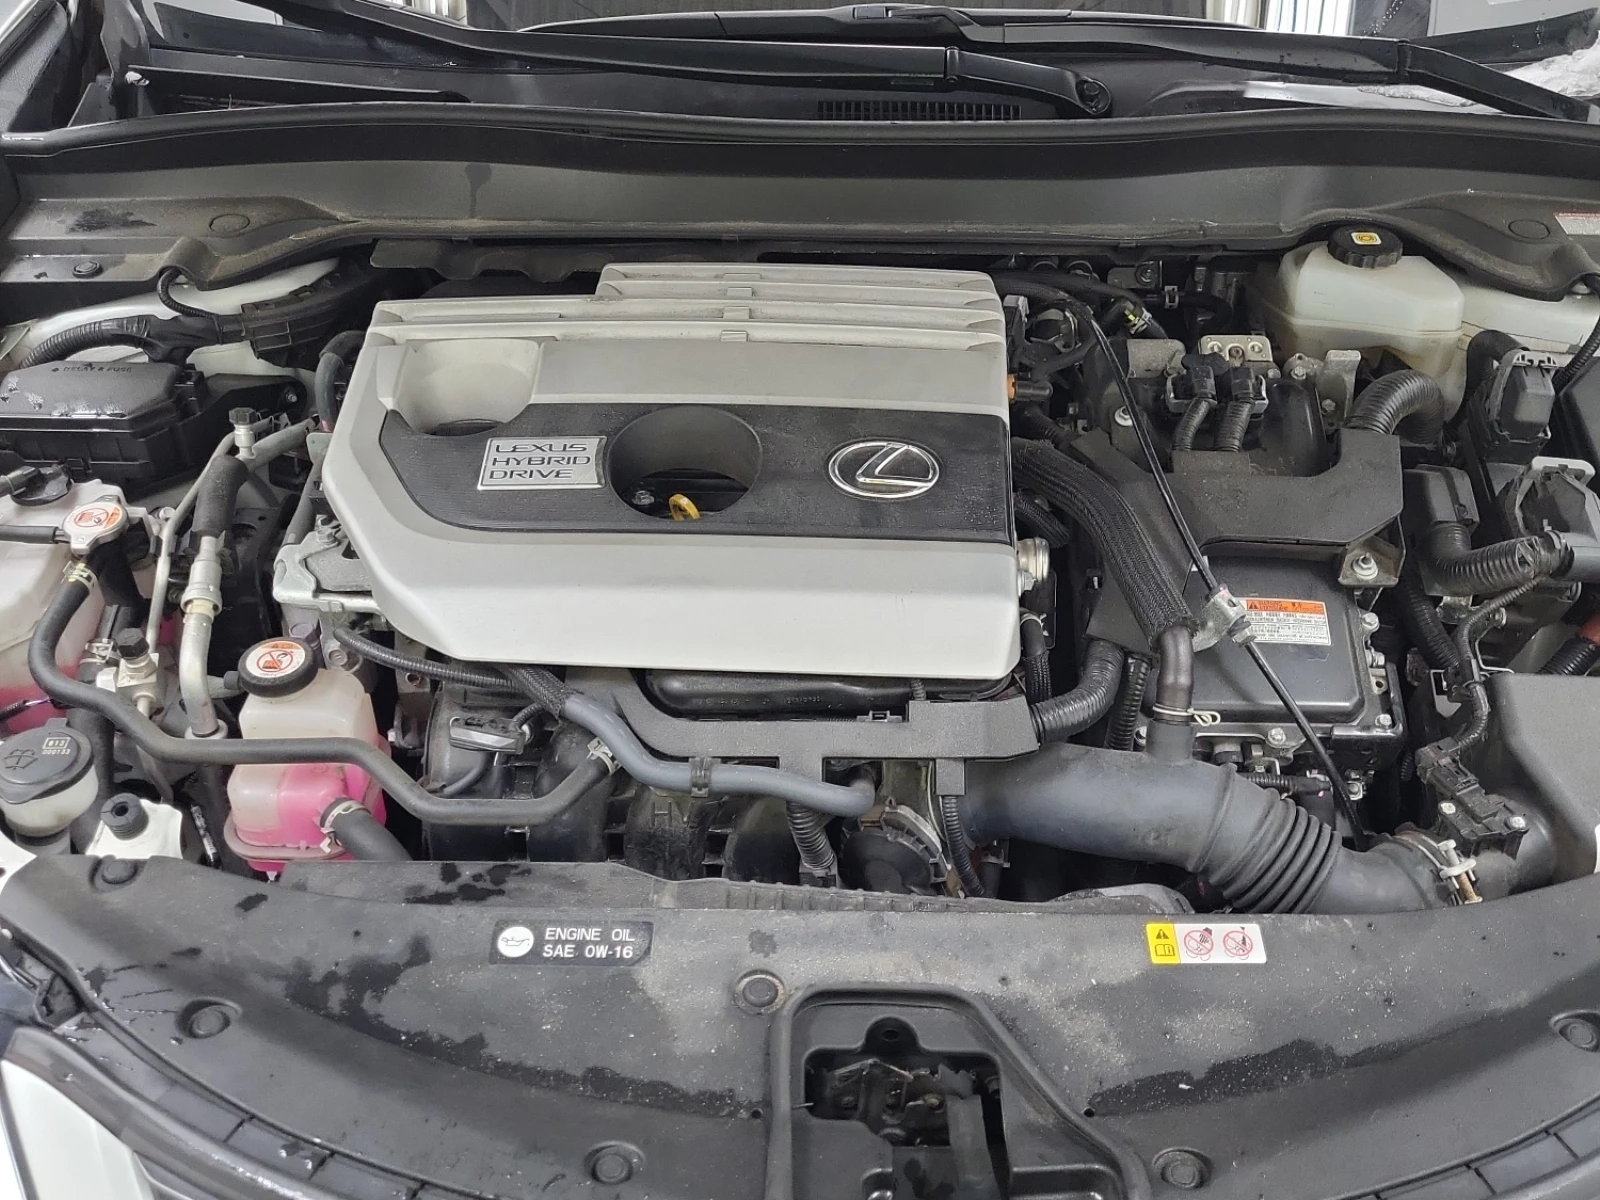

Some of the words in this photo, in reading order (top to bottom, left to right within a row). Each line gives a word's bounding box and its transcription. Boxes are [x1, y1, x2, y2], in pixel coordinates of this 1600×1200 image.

[495, 443, 588, 453] LEXUS
[492, 456, 591, 466] HYBRID
[489, 469, 574, 480] DRIVE
[545, 927, 602, 941] ENGINE
[611, 928, 636, 942] OIL
[542, 944, 575, 958] SAE
[584, 945, 633, 959] 0W-16
